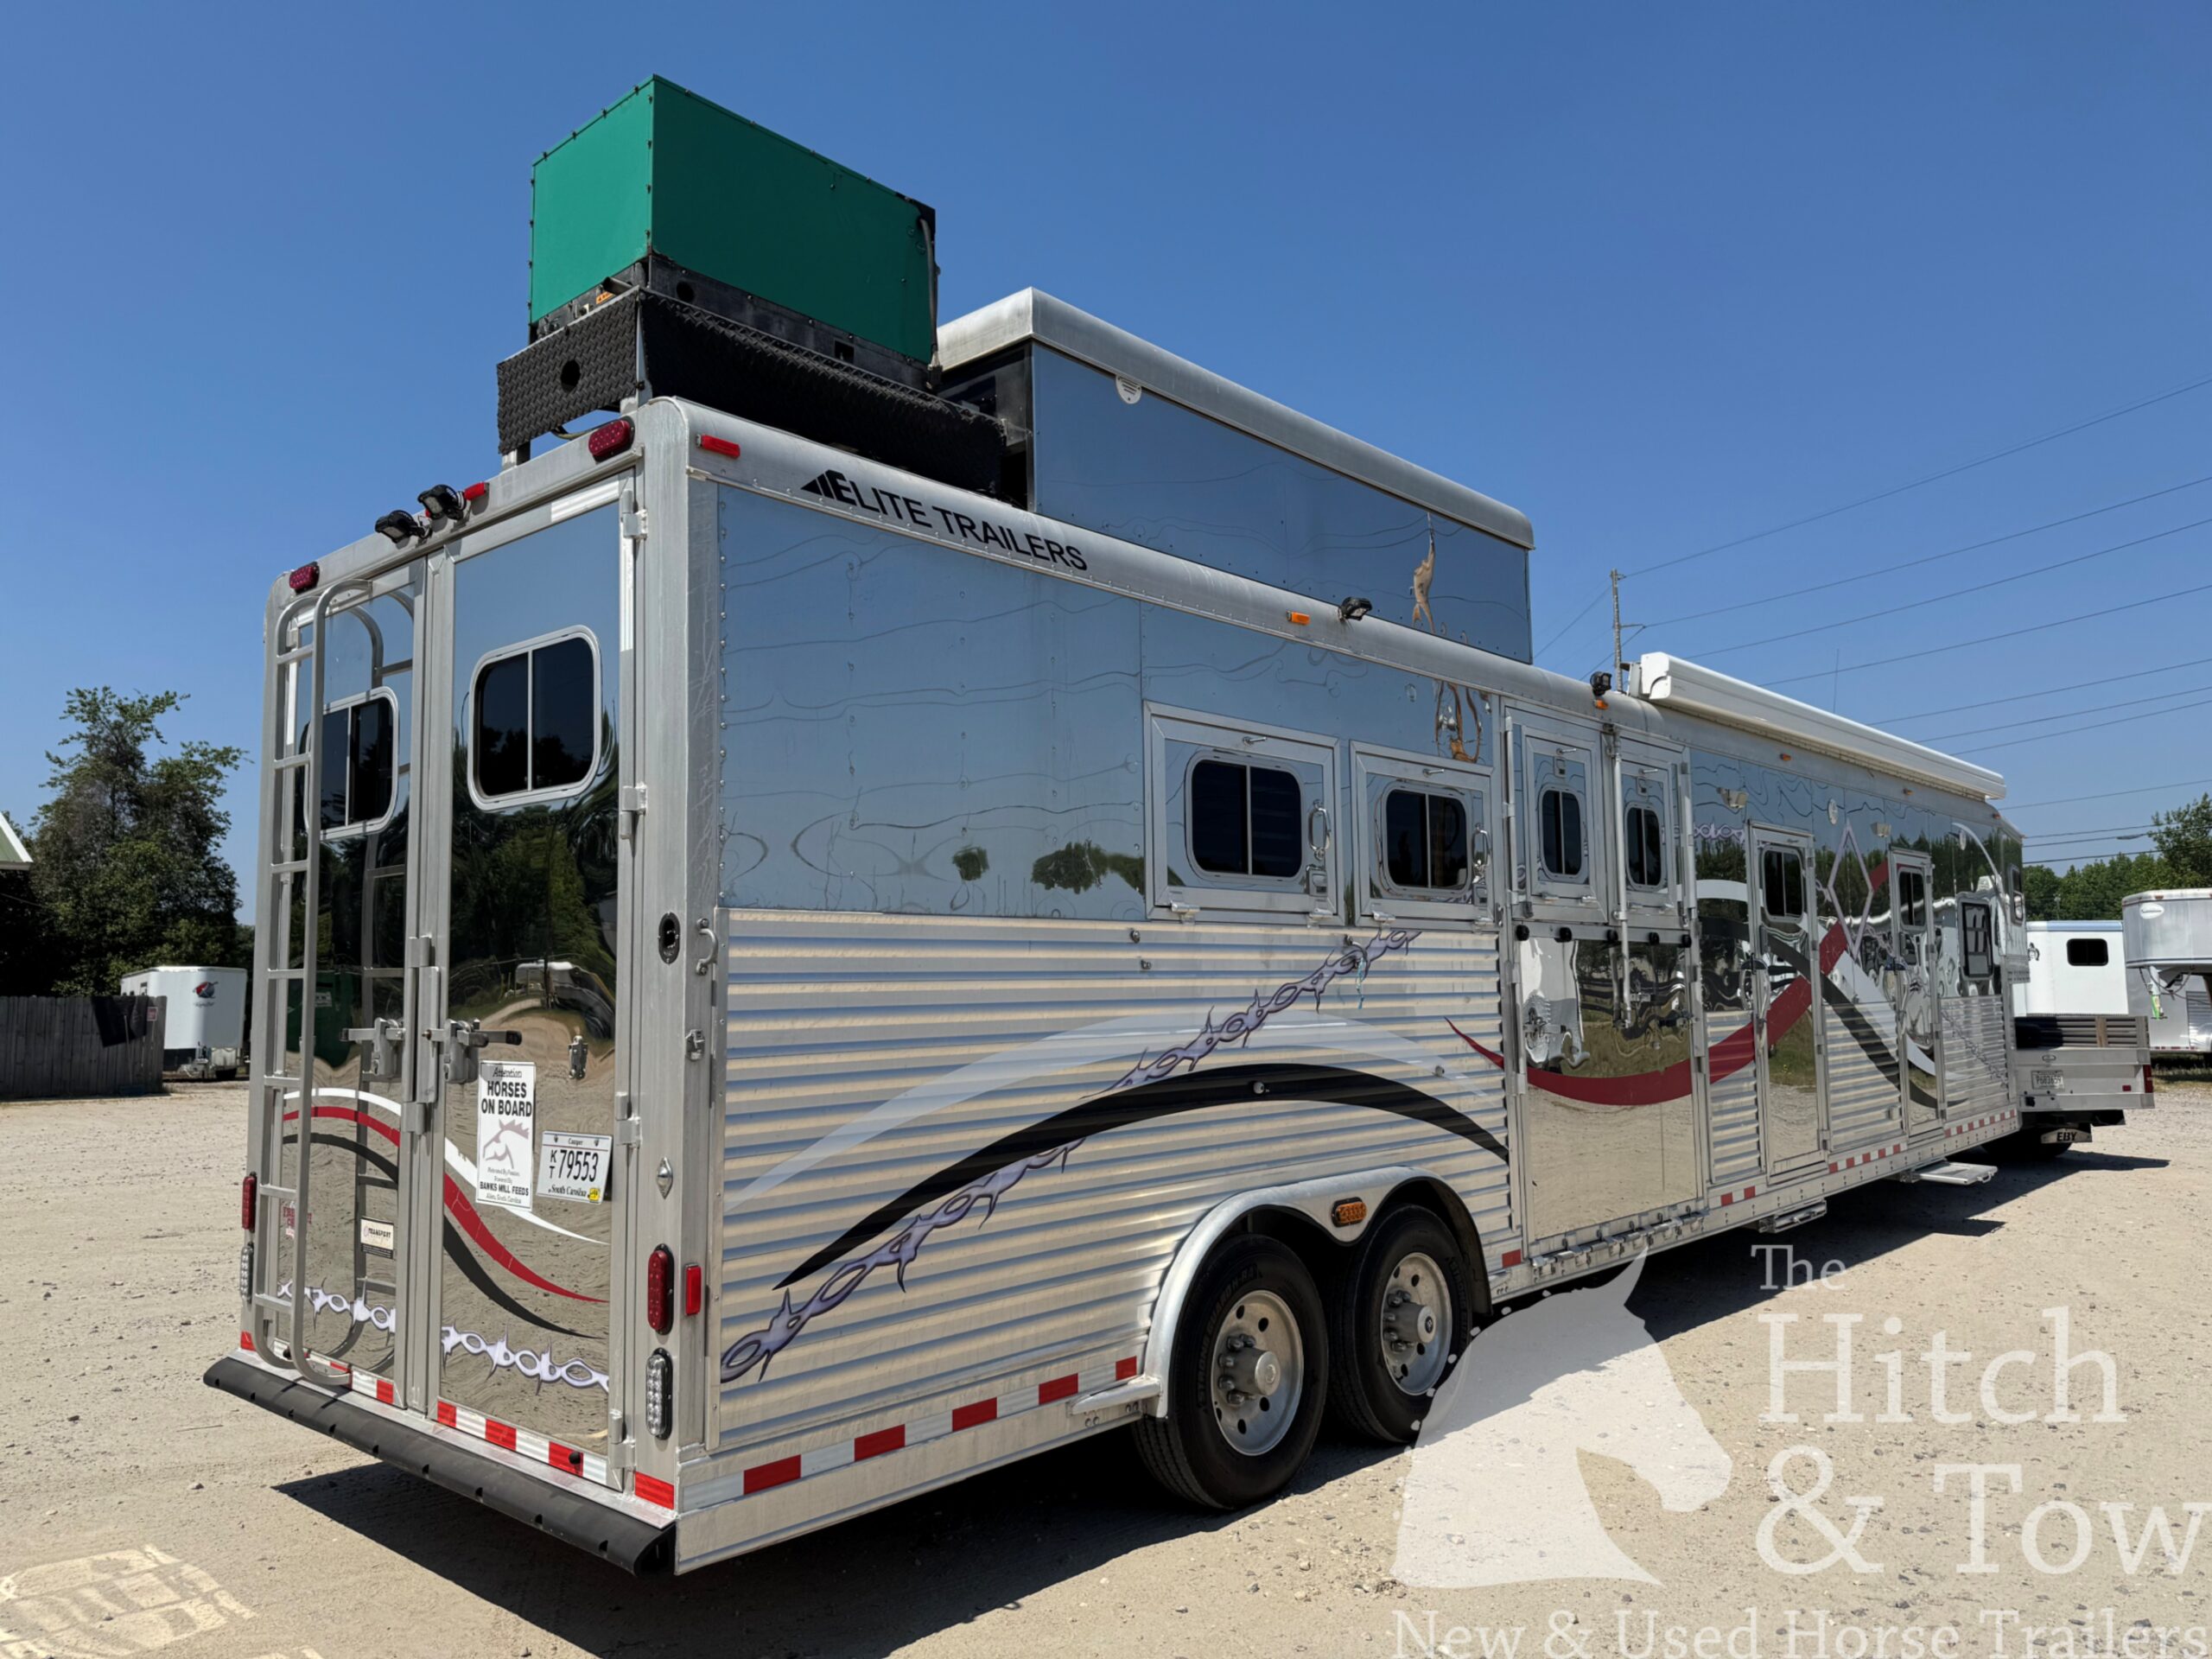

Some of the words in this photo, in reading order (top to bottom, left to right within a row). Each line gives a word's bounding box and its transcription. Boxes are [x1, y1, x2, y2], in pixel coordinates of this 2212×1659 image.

[804, 469, 933, 529] ELITE
[932, 505, 1088, 571] TRAILERS
[487, 1080, 527, 1098] HORSES
[481, 1098, 495, 1114] ON
[498, 1099, 532, 1117] BOARD
[2056, 1130, 2077, 1141] EBY
[558, 1149, 599, 1182] 79553
[480, 1180, 498, 1192] BANKS
[498, 1184, 511, 1193] MILL
[512, 1185, 530, 1196] FEEDS
[551, 1184, 566, 1195] South
[566, 1185, 588, 1198] Carolina
